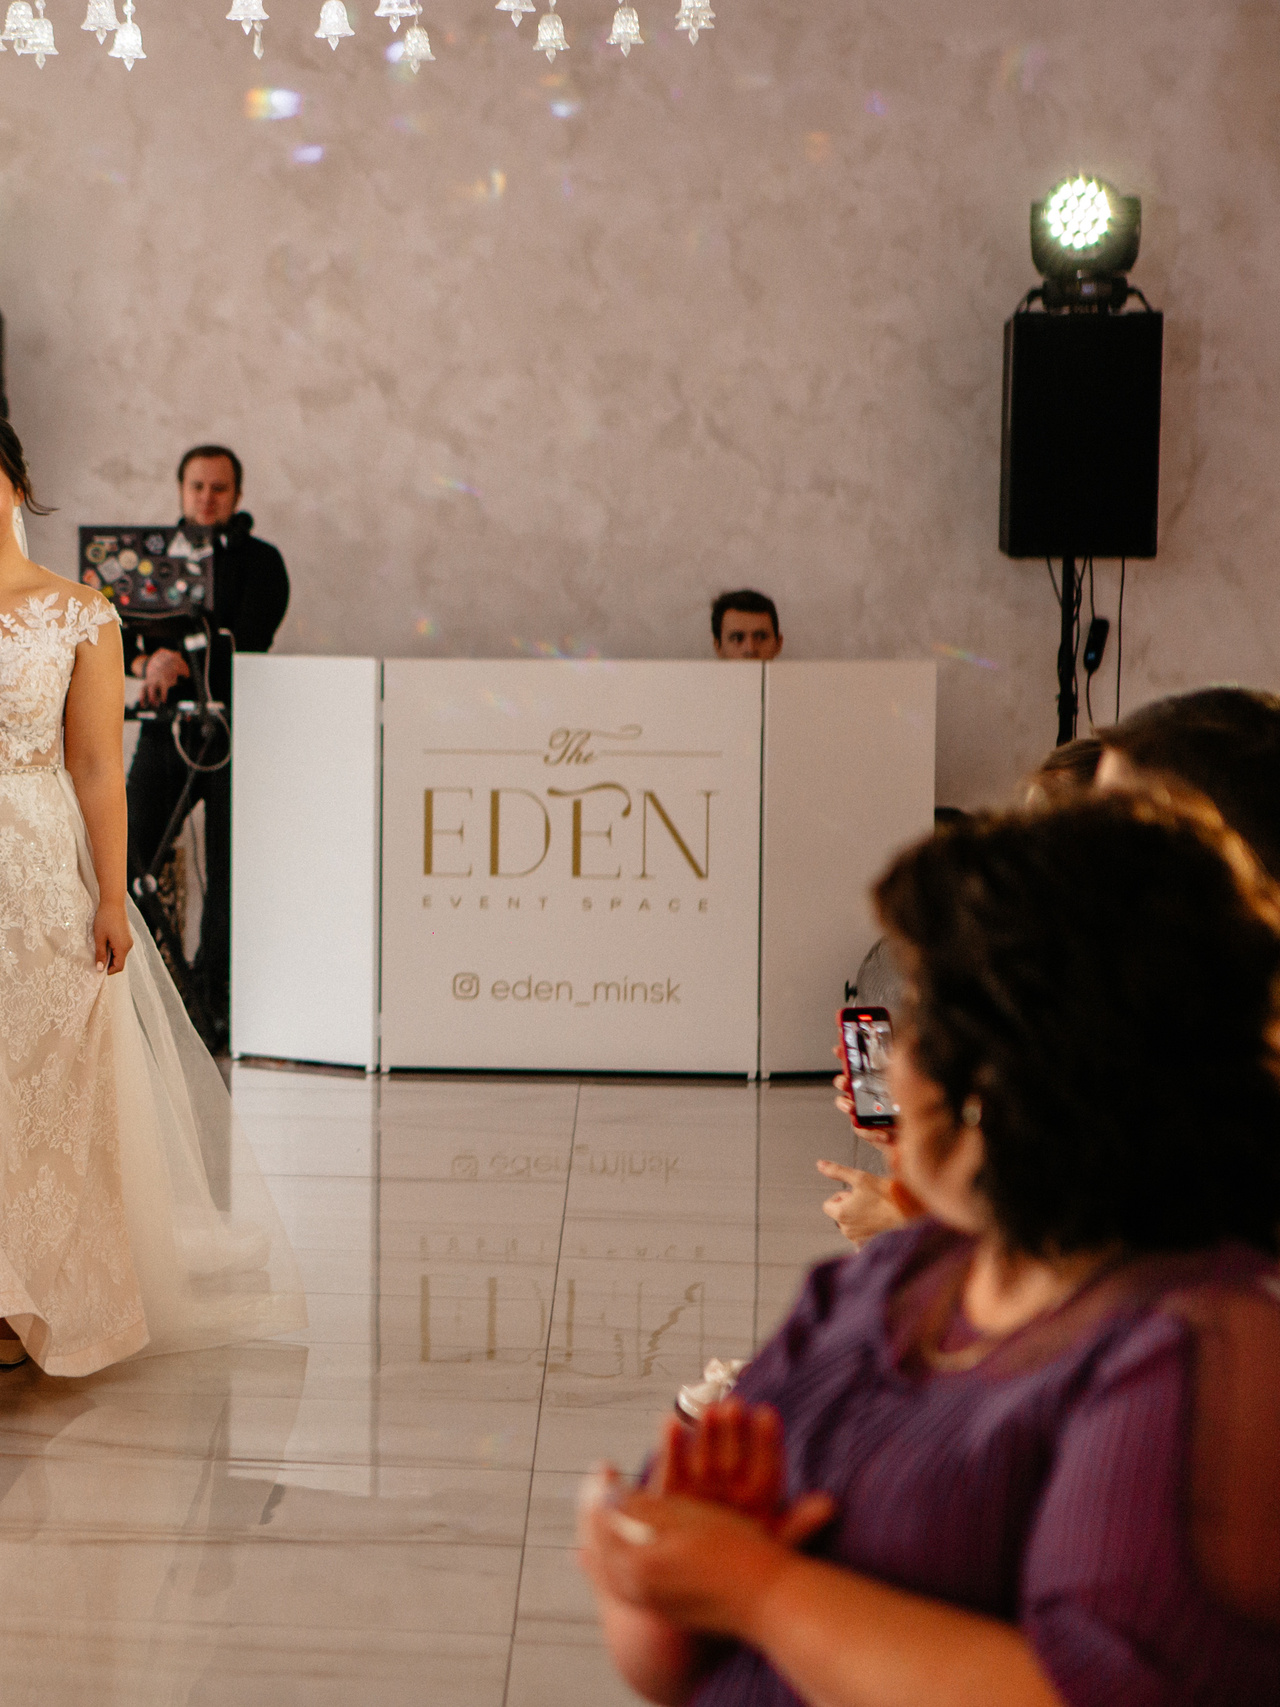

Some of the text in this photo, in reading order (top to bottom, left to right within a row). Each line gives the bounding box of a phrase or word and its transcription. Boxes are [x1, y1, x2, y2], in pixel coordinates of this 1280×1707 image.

[543, 724, 643, 767] The
[423, 781, 719, 880] EDEN
[422, 895, 709, 914] EVENT SPACE
[490, 974, 682, 1008] eden_minsk
